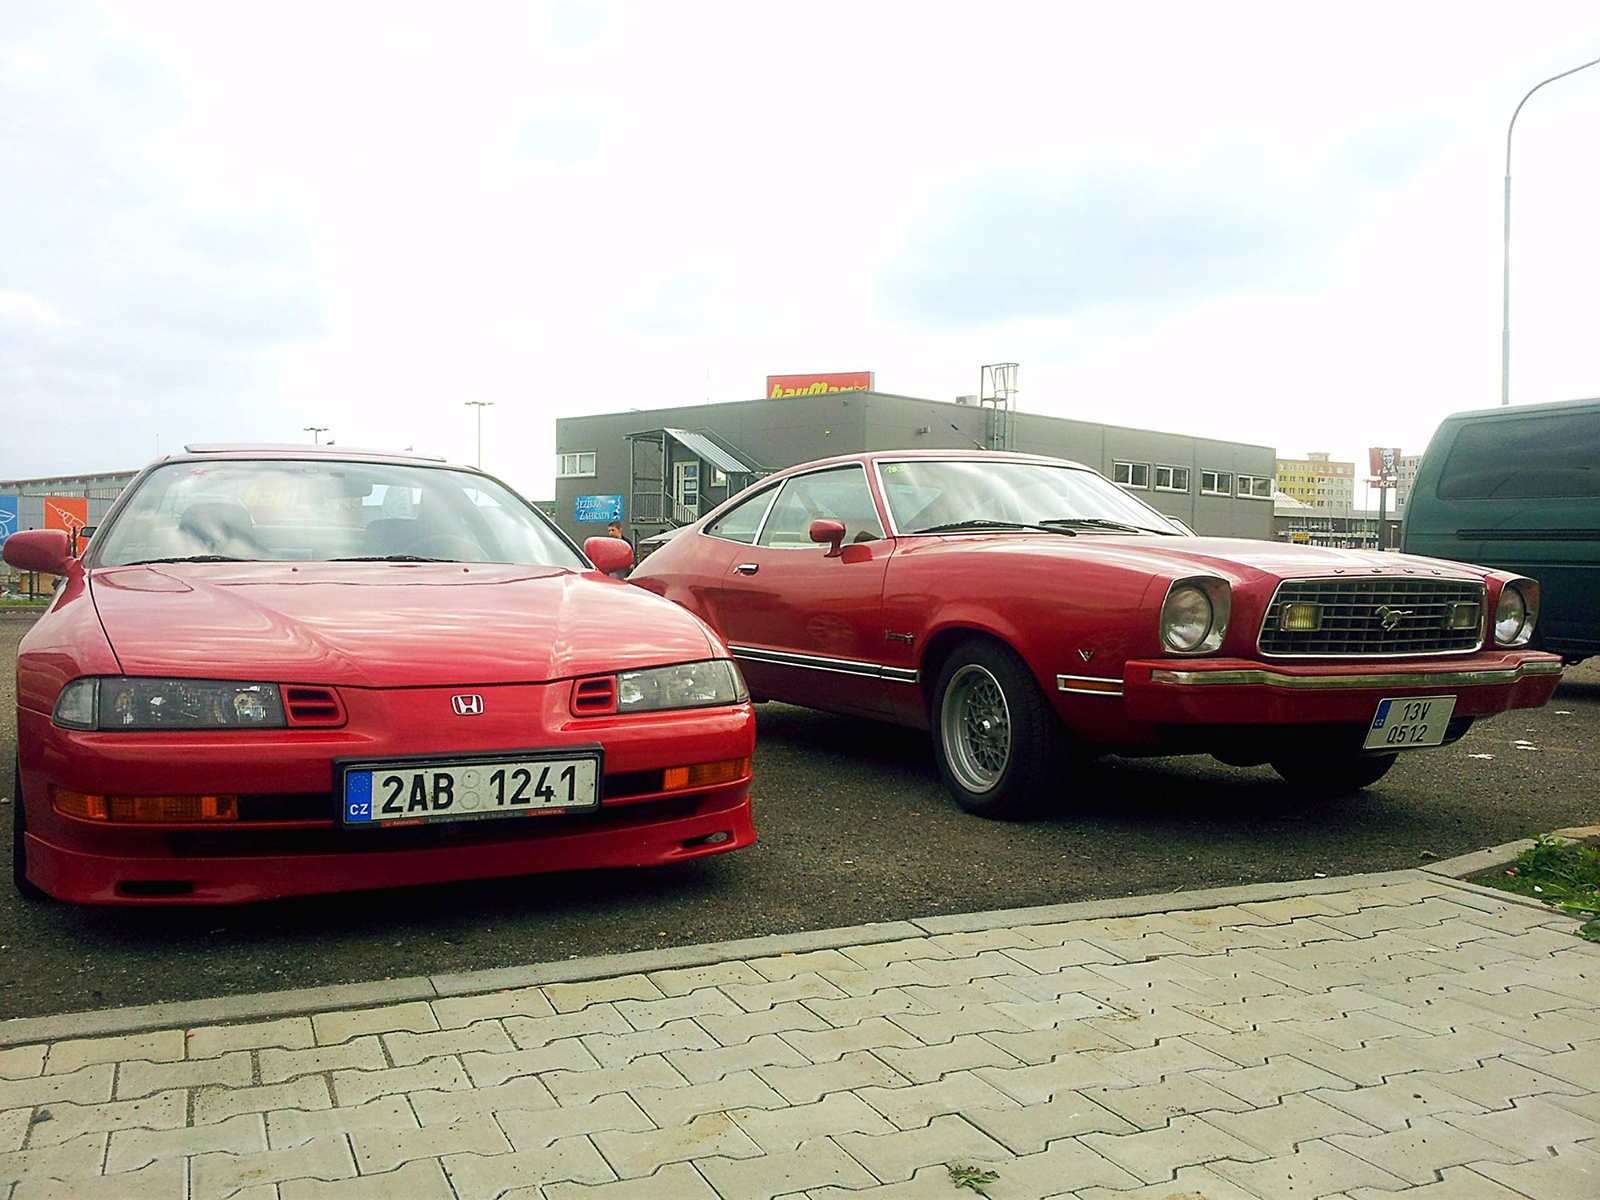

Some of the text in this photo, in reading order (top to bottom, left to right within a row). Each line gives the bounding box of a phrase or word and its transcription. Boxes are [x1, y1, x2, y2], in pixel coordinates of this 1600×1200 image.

[1402, 702, 1432, 721] 13V
[1386, 724, 1427, 744] 0512
[381, 772, 455, 814] 2AB
[489, 765, 576, 806] 1241
[350, 803, 369, 815] CZ
